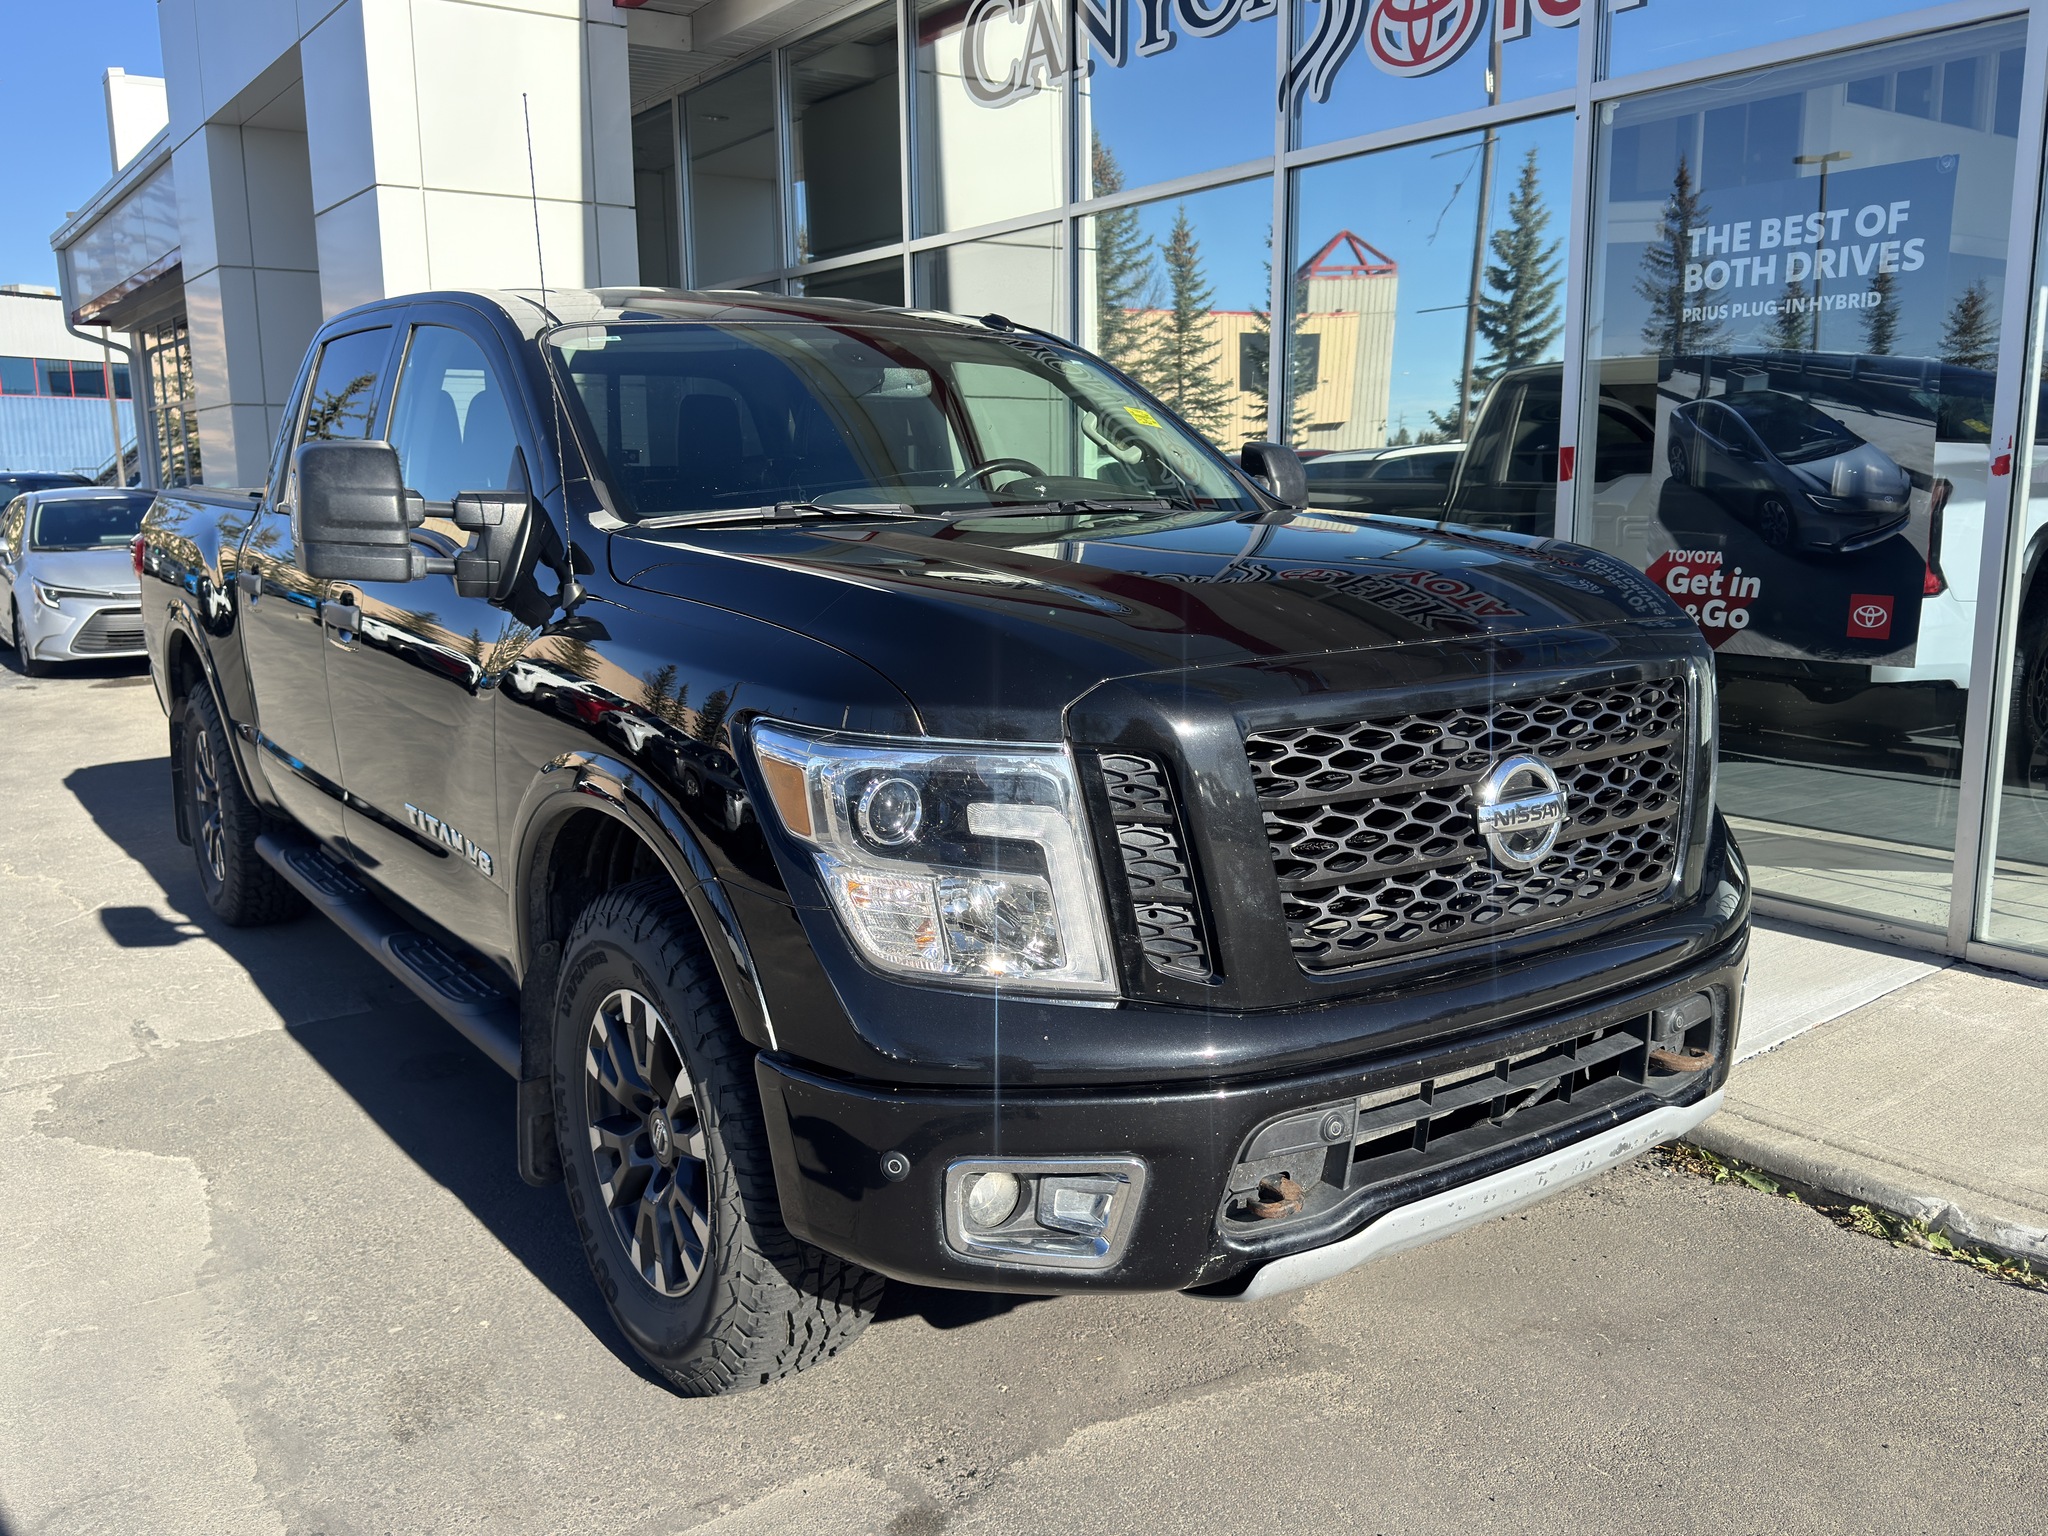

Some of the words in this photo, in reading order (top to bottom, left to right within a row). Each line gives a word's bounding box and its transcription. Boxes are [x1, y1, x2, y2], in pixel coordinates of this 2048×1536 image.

[1687, 221, 1752, 258] THE
[1759, 209, 1849, 250] BEST
[1855, 200, 1911, 238] OF
[1683, 254, 1777, 293] BOTH
[1785, 237, 1926, 284] DRIVES
[1682, 303, 1728, 323] PRIUS
[1732, 296, 1805, 319] PLUG-IN
[1809, 291, 1882, 312] HYBRID
[1668, 549, 1723, 565] TOYOTA
[1666, 566, 1724, 598] Get
[1729, 567, 1761, 599] in
[1494, 801, 1561, 827] NISSAN
[405, 802, 466, 857] TITAN
[466, 838, 494, 877] V8
